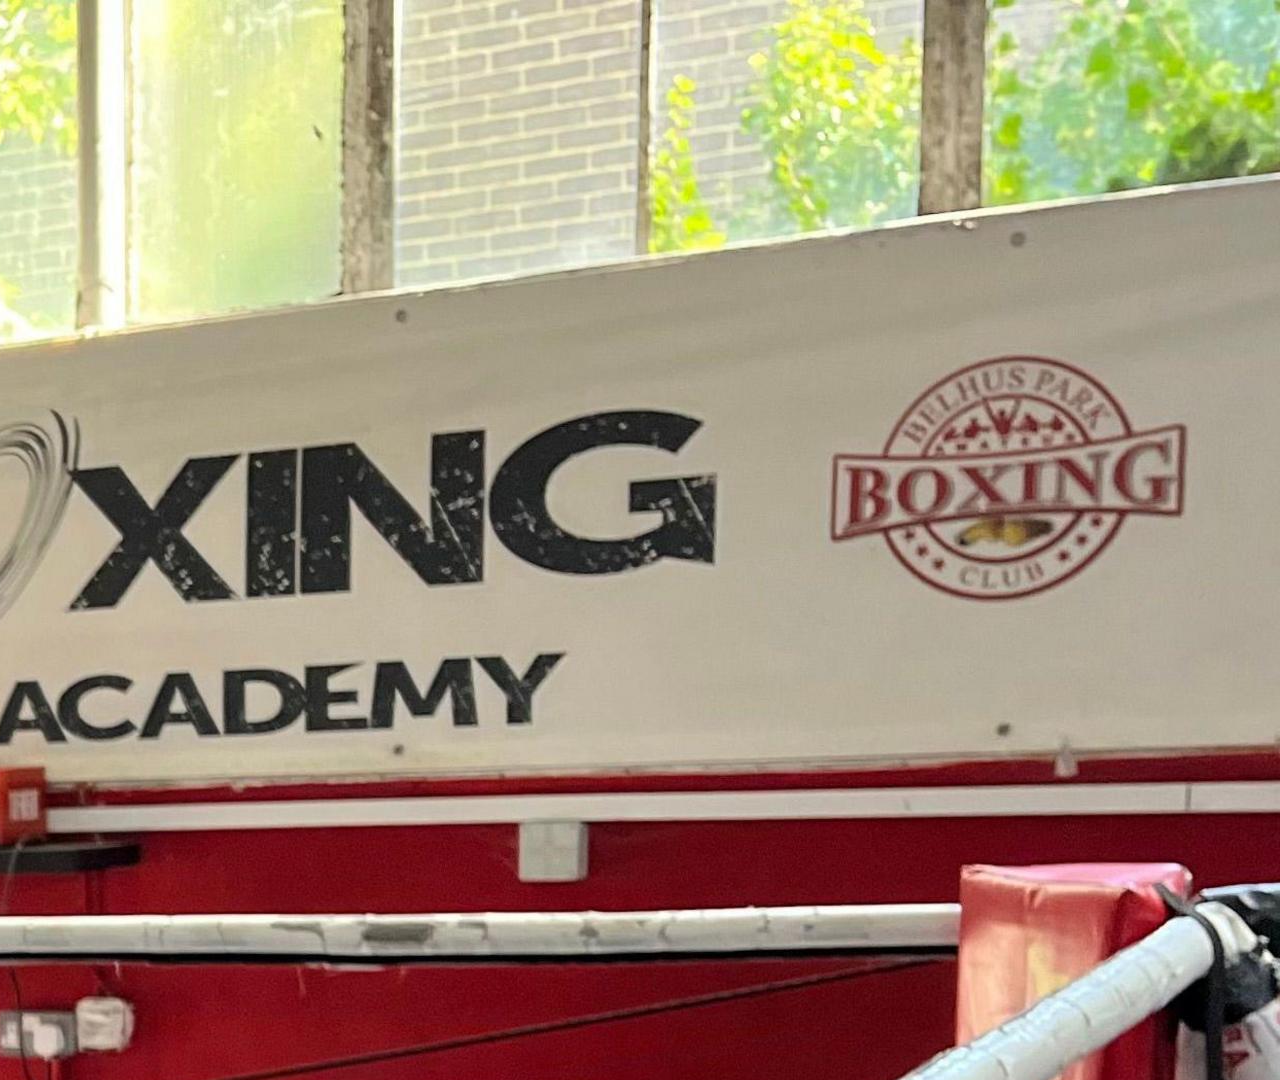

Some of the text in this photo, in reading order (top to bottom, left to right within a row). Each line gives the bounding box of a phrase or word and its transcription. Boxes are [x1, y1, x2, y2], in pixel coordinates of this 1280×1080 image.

[901, 365, 1112, 448] BELHUS PARK
[843, 437, 1178, 530] BOXING
[958, 563, 1046, 589] CLUB
